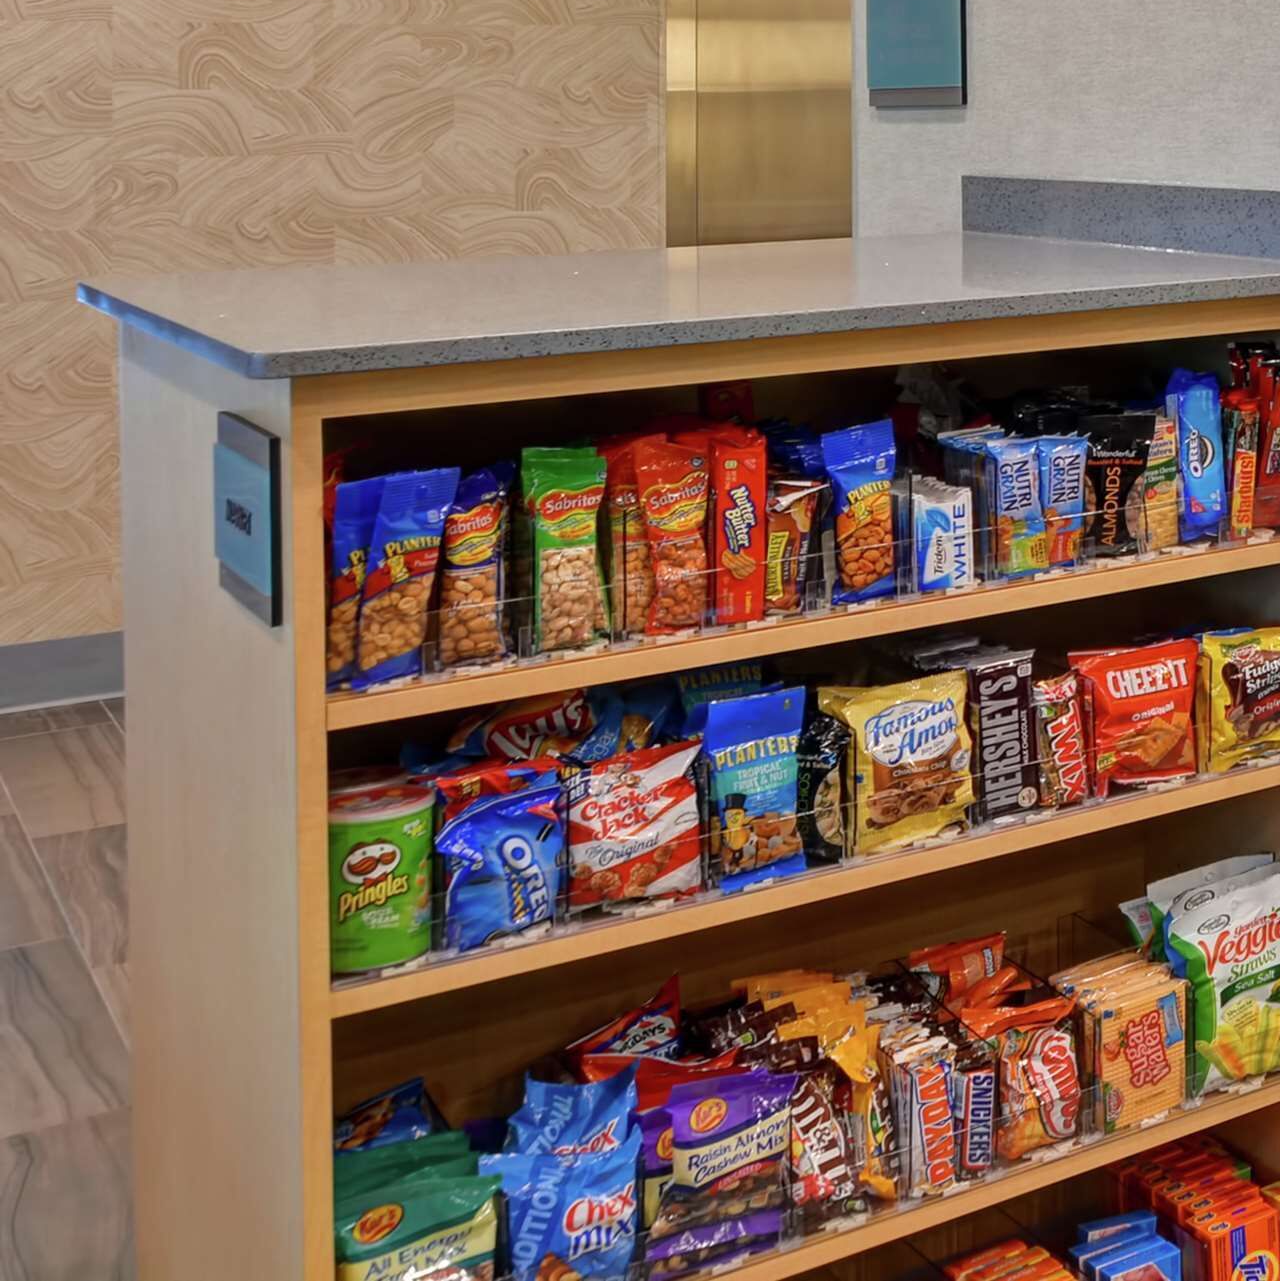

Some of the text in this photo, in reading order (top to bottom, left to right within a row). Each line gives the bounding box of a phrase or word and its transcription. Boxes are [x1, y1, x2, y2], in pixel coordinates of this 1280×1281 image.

[1189, 428, 1202, 478] OREO
[650, 483, 707, 510] Sabritas
[1000, 464, 1019, 512] GRAIN
[1013, 460, 1033, 508] NUTRI
[1052, 456, 1067, 504] GRAIN
[1065, 454, 1081, 501] NUTRI
[545, 494, 601, 514] Sabritas
[725, 508, 750, 548] Butter
[730, 486, 756, 526] Nutter
[1101, 466, 1121, 546] ALMONDS
[384, 535, 442, 559] PLANTER
[953, 503, 966, 580] WHITE
[864, 697, 954, 748] Famous
[888, 717, 957, 765] Amos
[979, 675, 1022, 810] HERSHEY'S
[714, 735, 800, 771] PLANTERS
[1046, 700, 1087, 802] TWIX
[580, 783, 667, 821] Cracker
[593, 806, 652, 841] Jack
[599, 832, 661, 866] Original
[339, 873, 409, 921] Pringles
[503, 836, 548, 921] OREO
[1227, 947, 1277, 983] Straws
[1234, 970, 1276, 993] Sea Salt
[1125, 1021, 1148, 1087] Sugar
[1143, 1010, 1170, 1086] Wafers
[969, 1074, 993, 1163] SNICKERS
[687, 1144, 732, 1171] Raisin
[692, 1146, 753, 1185] Cashew
[756, 1135, 785, 1156] Mix
[564, 1182, 635, 1234] Chex
[364, 1227, 473, 1281] All Energy
